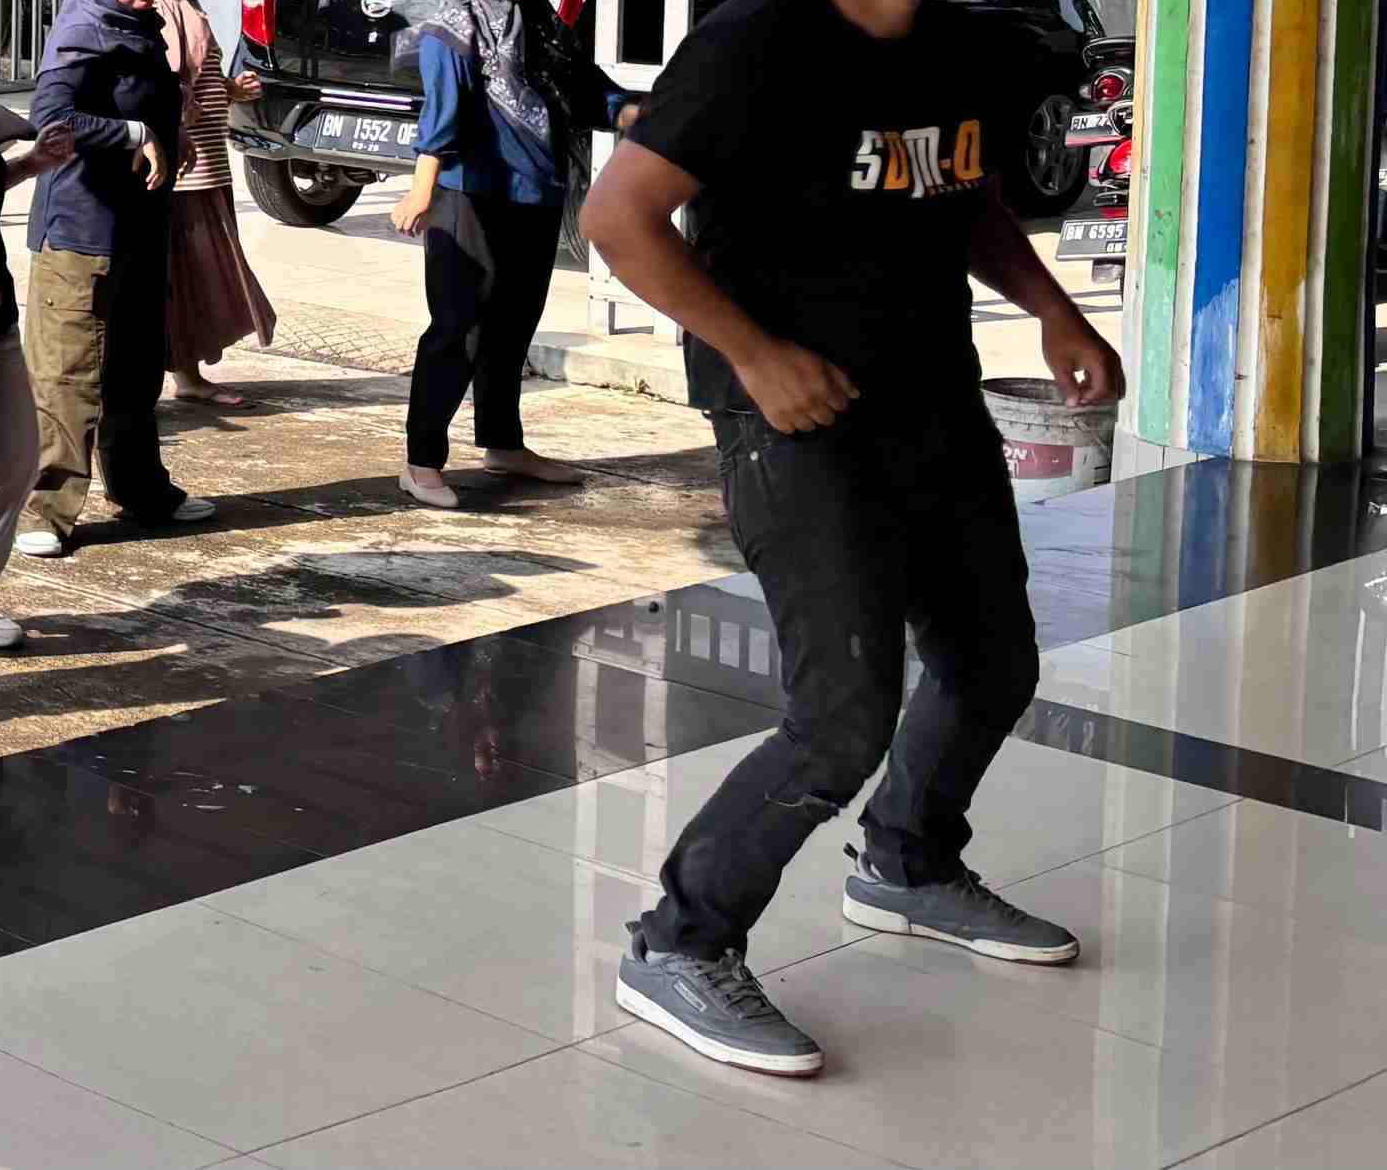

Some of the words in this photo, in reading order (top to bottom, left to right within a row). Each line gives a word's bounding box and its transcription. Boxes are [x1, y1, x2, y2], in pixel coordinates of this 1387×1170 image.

[322, 114, 344, 138] BN
[353, 117, 392, 142] 1552
[1088, 223, 1124, 240] 6595
